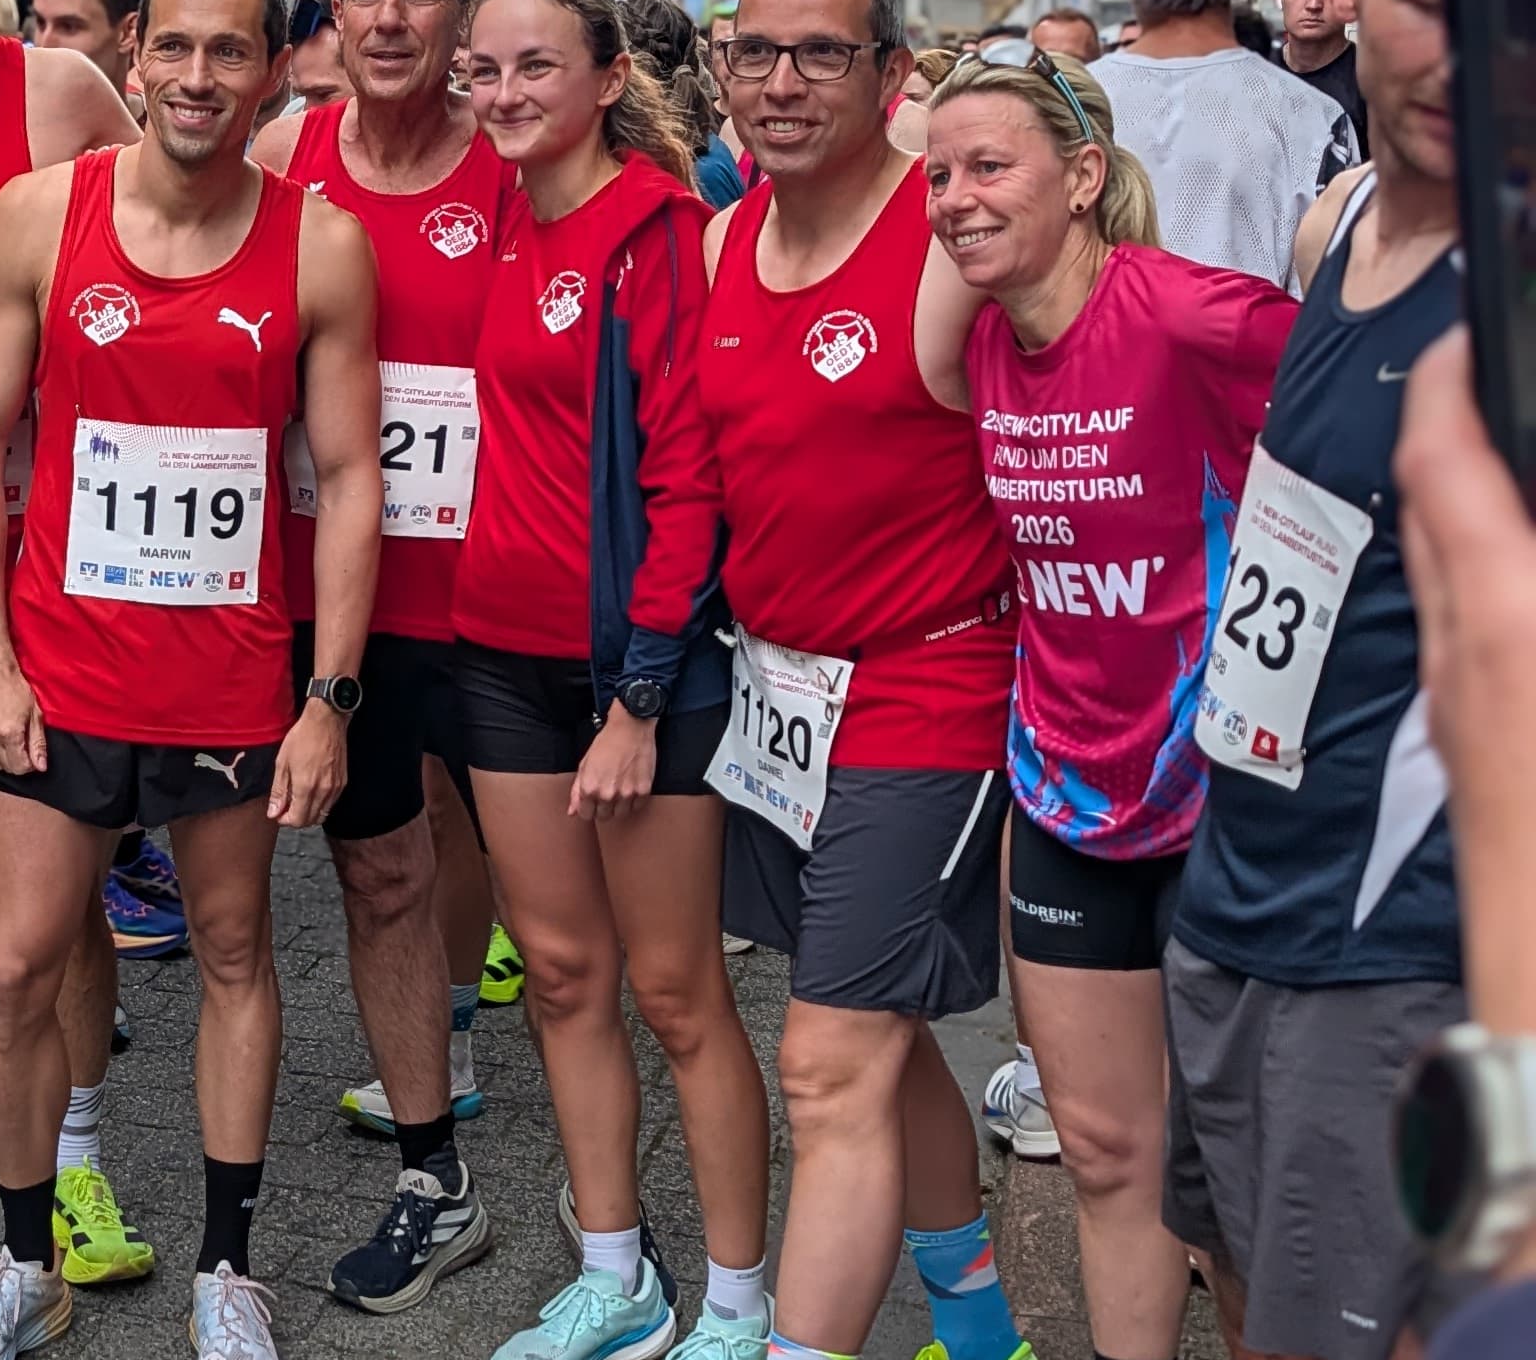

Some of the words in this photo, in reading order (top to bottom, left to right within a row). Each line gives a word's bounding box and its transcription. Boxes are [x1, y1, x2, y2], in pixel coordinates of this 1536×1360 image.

[438, 219, 465, 238] TuS
[445, 230, 468, 246] OEDT
[450, 238, 473, 254] 1884
[551, 301, 574, 321] OEDT
[552, 289, 572, 310] TuS
[88, 302, 116, 322] TuS
[94, 314, 120, 332] OEDT
[554, 310, 576, 329] 1884
[99, 323, 124, 341] 1884
[820, 331, 849, 356] TuS
[826, 342, 853, 367] OEDT
[831, 352, 860, 375] 1884
[380, 421, 448, 474] 21
[1031, 447, 1057, 470] UM
[1062, 444, 1108, 469] DEN
[985, 473, 1144, 503] MBERTUSTURM
[96, 481, 244, 539] 1119
[1012, 514, 1075, 546] 2026
[139, 546, 191, 560] MARVIN
[1224, 561, 1306, 671] 23
[741, 683, 812, 773] 1120
[757, 759, 785, 782] DANIEL
